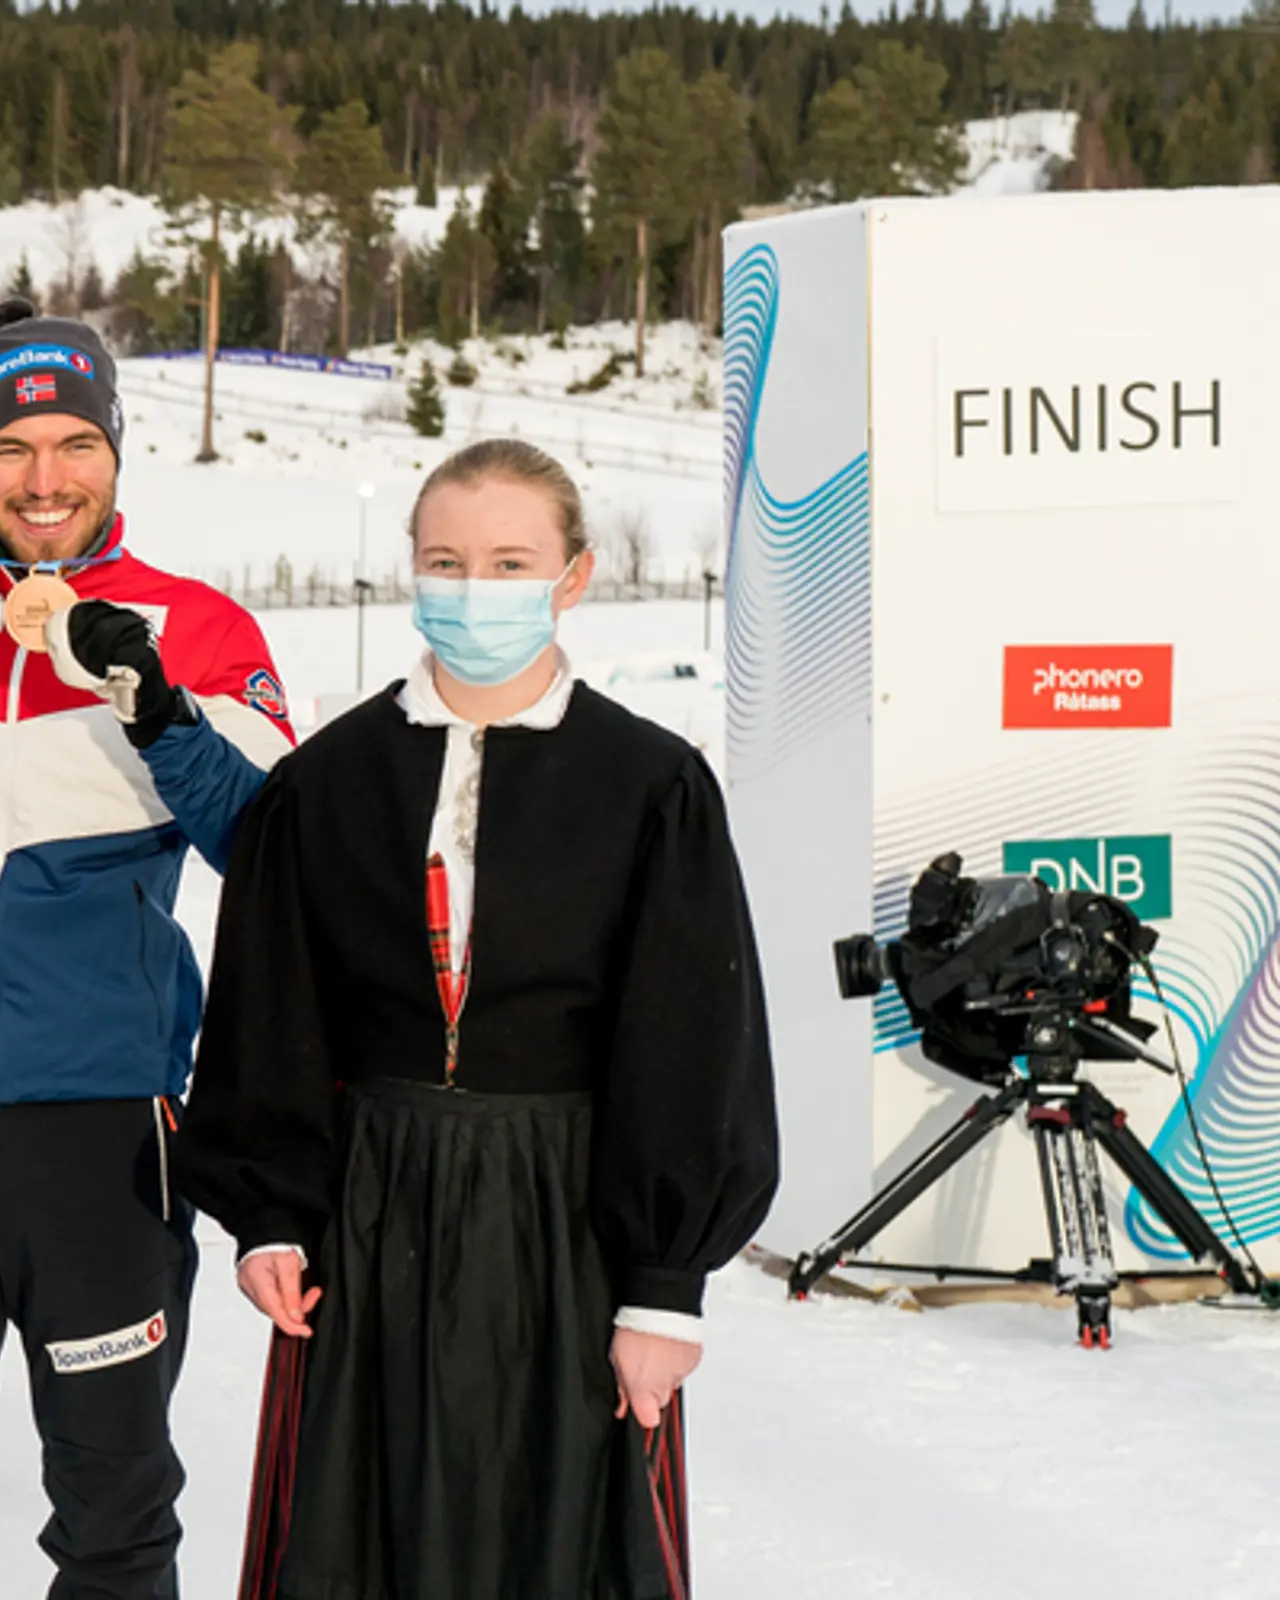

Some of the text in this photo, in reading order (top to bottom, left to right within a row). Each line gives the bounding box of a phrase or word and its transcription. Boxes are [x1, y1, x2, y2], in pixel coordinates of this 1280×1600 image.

[953, 378, 1222, 458] FINISH
[1033, 662, 1143, 696] phonero
[1055, 692, 1121, 712] Råtass
[54, 1332, 148, 1368] SpareBank
